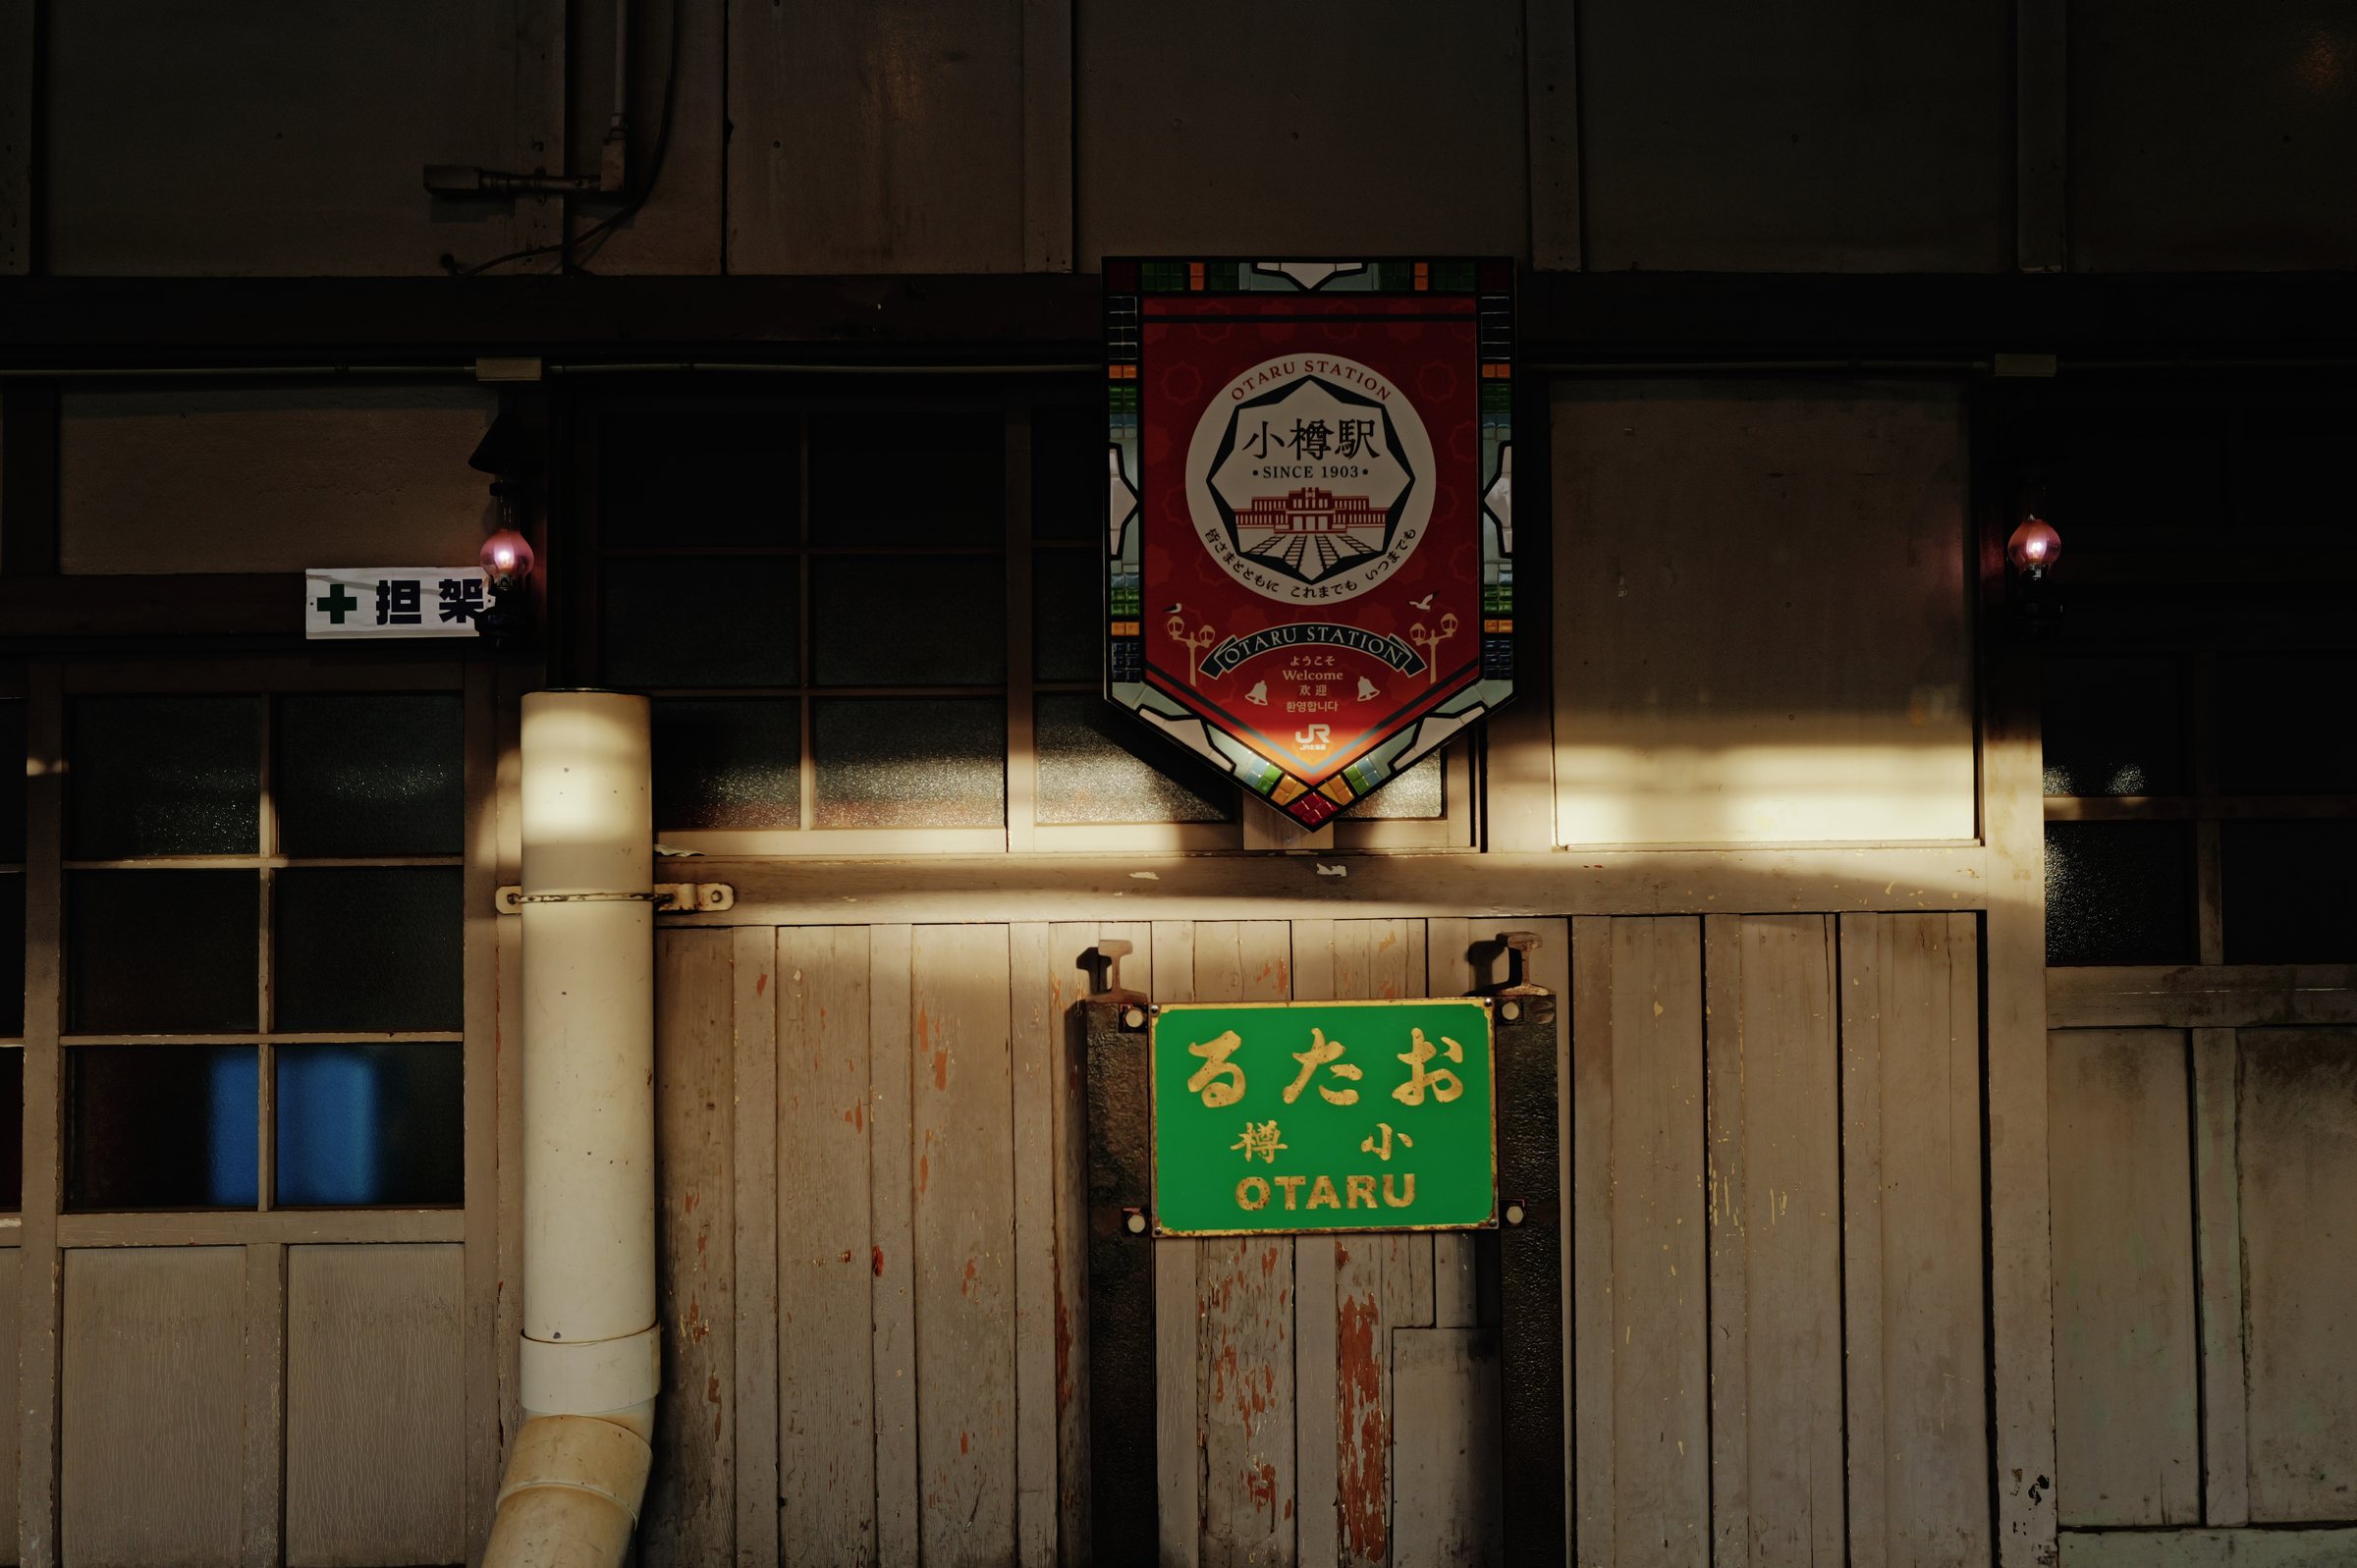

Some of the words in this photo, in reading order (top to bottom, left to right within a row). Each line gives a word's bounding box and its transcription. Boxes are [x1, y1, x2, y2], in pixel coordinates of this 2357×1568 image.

[1232, 361, 1294, 401] OTARU
[1304, 360, 1391, 401] STATION
[1242, 418, 1380, 460] 小樽駅
[1263, 465, 1314, 478] SINCE
[1322, 465, 1358, 478] 1903
[1204, 528, 1279, 593] 皆さまとともに
[1290, 580, 1357, 598] これまでも
[1365, 528, 1416, 580] いつまでも
[376, 578, 484, 625] 担架
[1225, 627, 1297, 665] OTARU
[1306, 625, 1403, 666] STATION
[1289, 655, 1336, 667] ようこそ
[1282, 670, 1343, 680] Welcome
[1295, 724, 1330, 743] JR
[1234, 1173, 1416, 1211] OTARU
